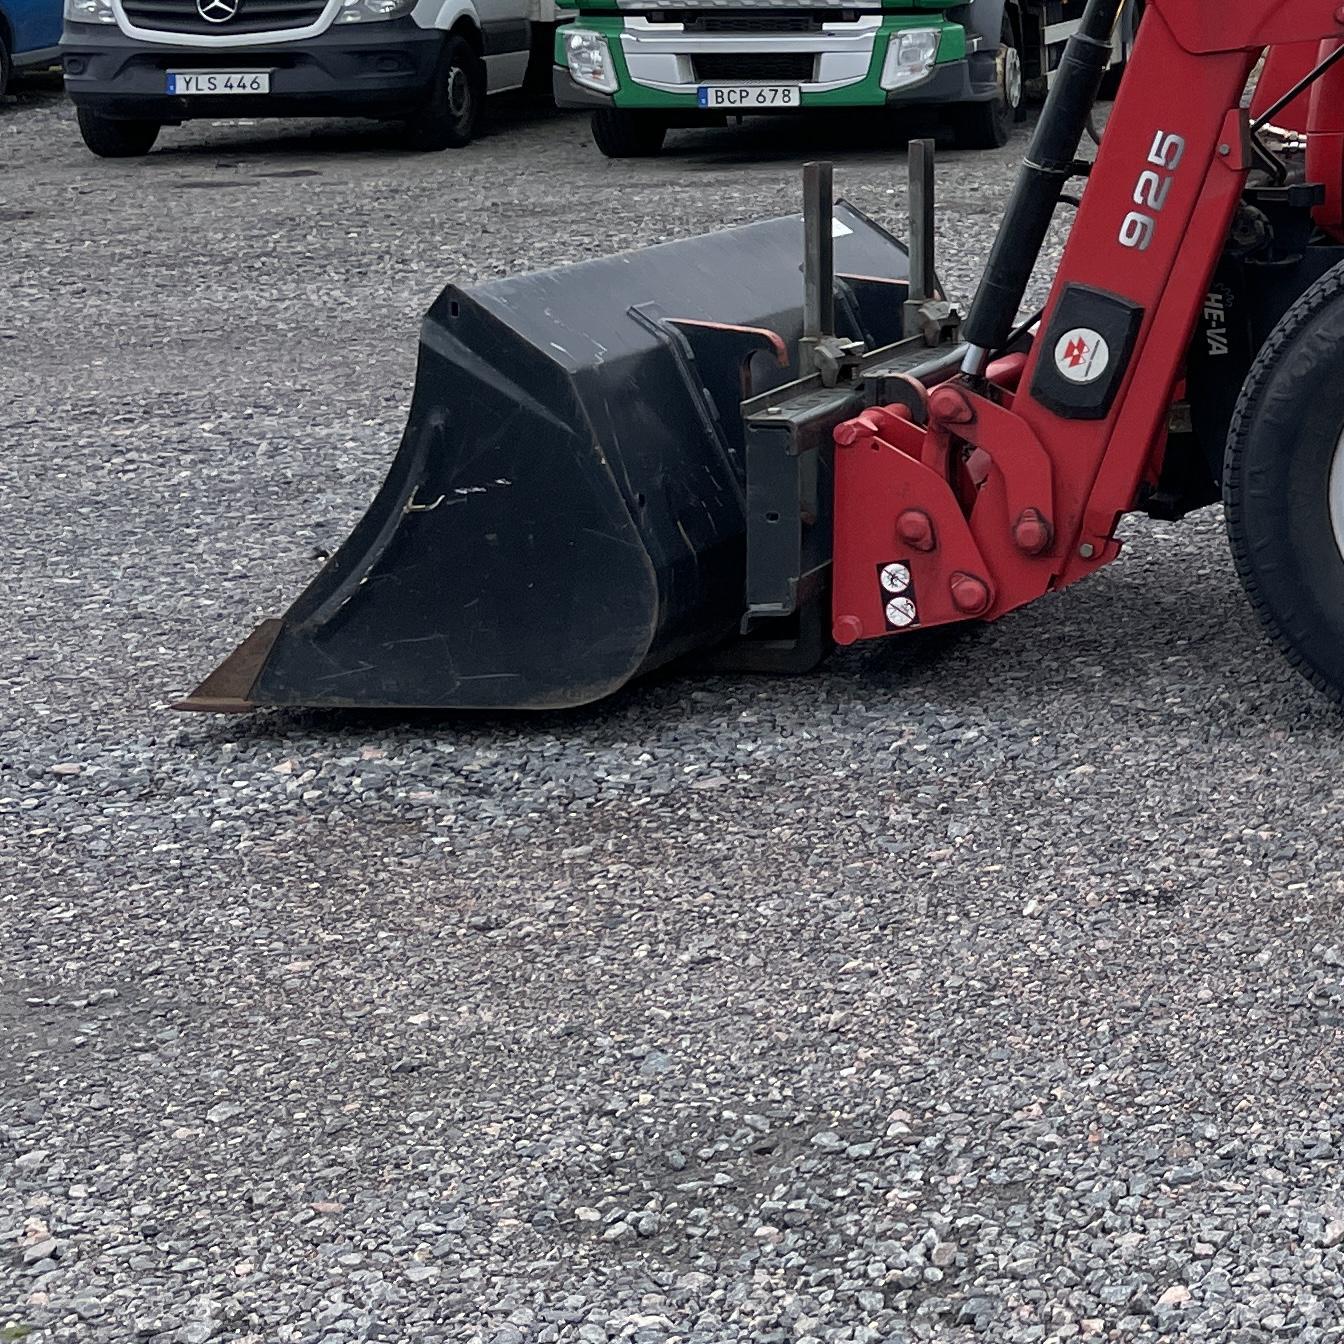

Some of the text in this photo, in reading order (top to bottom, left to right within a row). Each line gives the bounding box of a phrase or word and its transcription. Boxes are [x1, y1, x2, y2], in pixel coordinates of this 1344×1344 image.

[183, 75, 260, 92] YLS 446
[714, 88, 792, 105] BCP 678
[1118, 129, 1185, 251] 925
[1203, 293, 1229, 355] HE-VA
